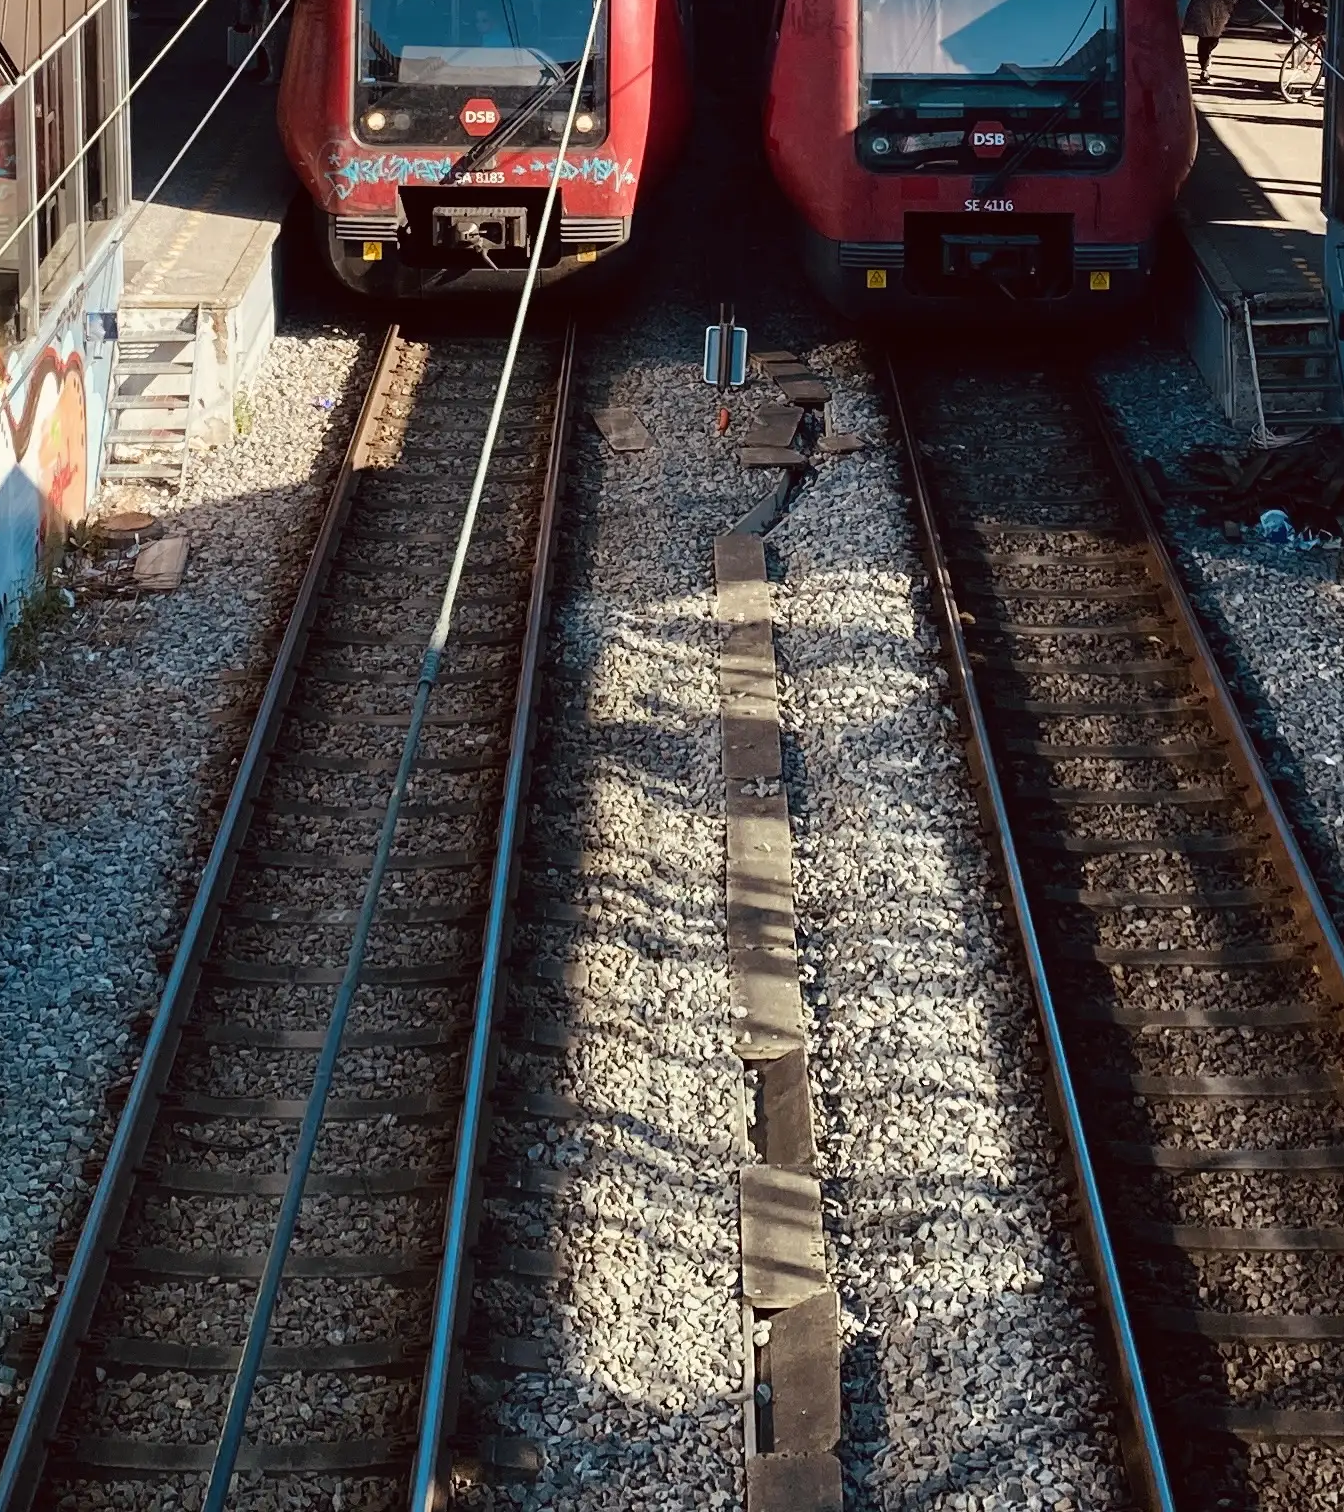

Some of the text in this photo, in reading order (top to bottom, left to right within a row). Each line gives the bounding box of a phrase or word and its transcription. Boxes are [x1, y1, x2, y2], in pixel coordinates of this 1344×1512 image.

[465, 110, 496, 124] DSB
[973, 132, 1005, 146] DSB
[455, 172, 505, 184] SA 8183
[964, 199, 1014, 212] SE 4116
